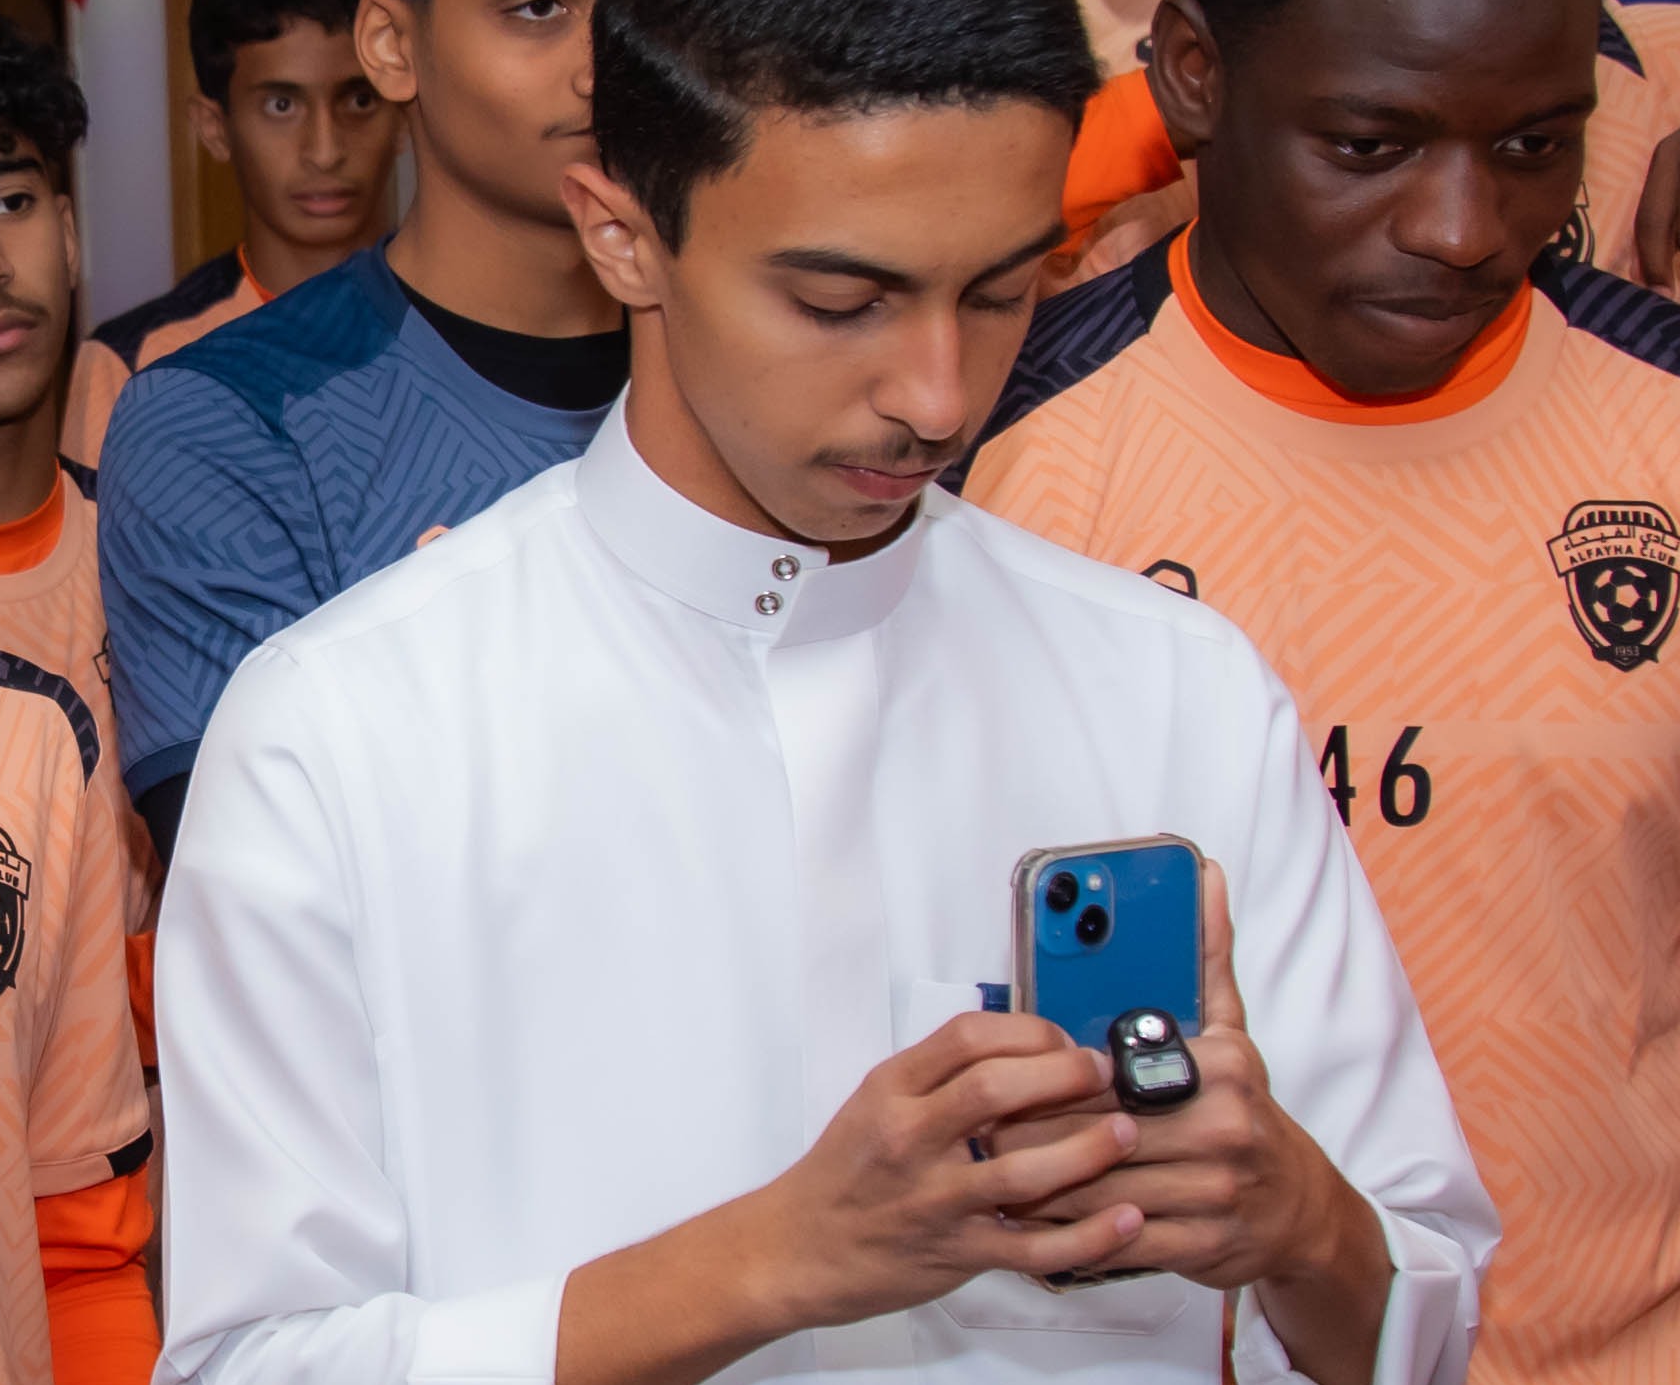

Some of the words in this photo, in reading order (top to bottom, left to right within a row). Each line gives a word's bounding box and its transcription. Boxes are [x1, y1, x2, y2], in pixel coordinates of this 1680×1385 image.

[1569, 545, 1634, 564] ALFAYHA
[1640, 547, 1676, 566] CLUB
[1319, 725, 1432, 827] 46
